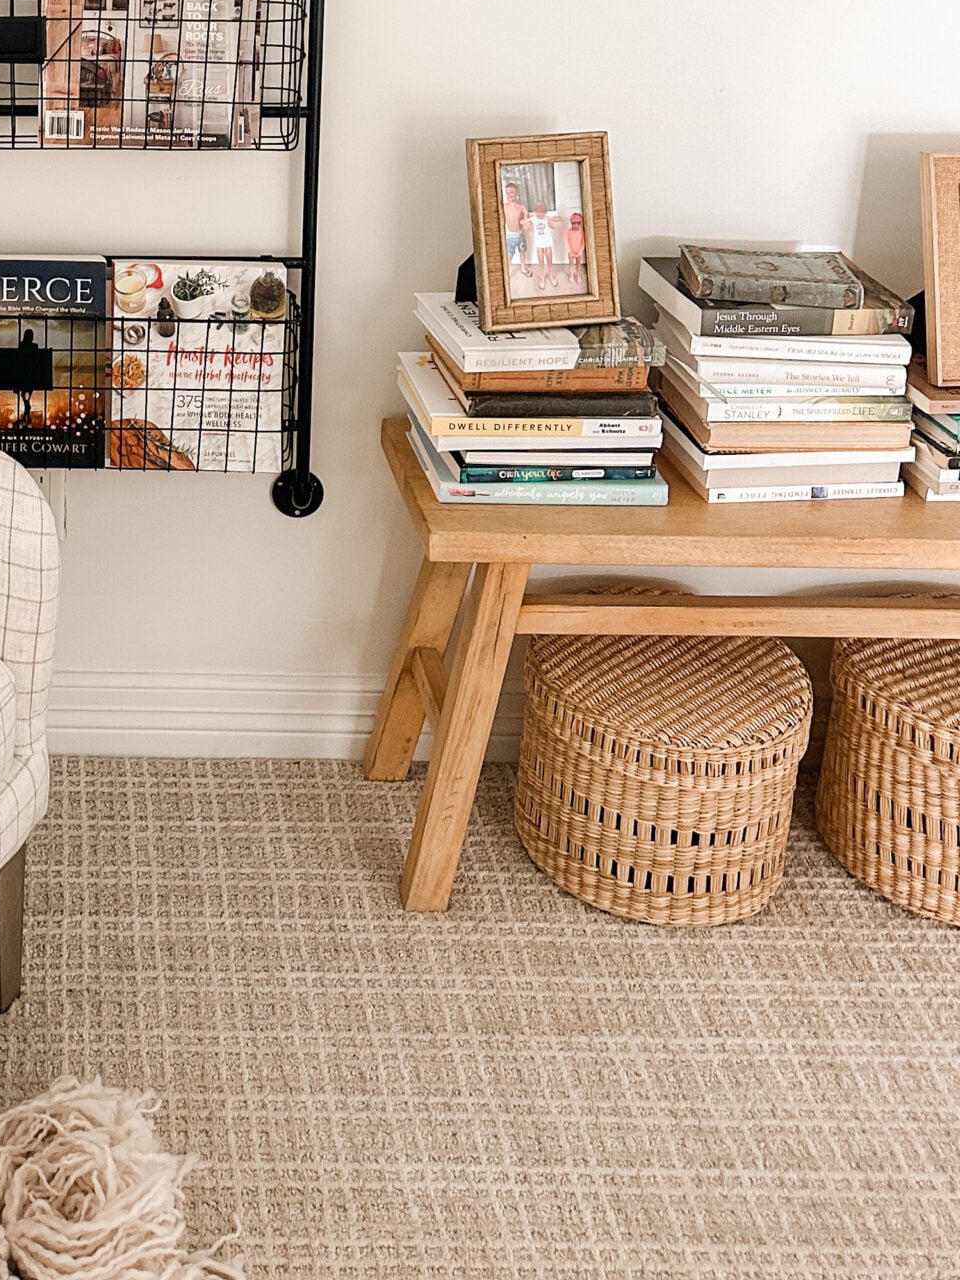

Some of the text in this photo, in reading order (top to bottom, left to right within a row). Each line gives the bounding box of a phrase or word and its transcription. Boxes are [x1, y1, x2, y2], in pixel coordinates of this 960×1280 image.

[186, 2, 218, 12] BACK
[186, 12, 202, 20] TO
[185, 22, 218, 31] YOUR
[185, 31, 224, 41] ROOTS
[178, 80, 222, 96] Pus
[714, 312, 778, 323] Jesus Through
[713, 324, 801, 335] Middle Eastern Eyes
[223, 344, 274, 370] Recipes
[475, 356, 569, 368] RESILIENT HOPE
[785, 372, 860, 383] The Stories We Tell
[176, 394, 203, 409] 375
[724, 409, 771, 419] STANLEY
[852, 406, 876, 416] LIFE
[448, 422, 573, 432] DWELL DIFFERENTLY
[31, 441, 88, 454] COWART
[521, 469, 546, 481] your
[589, 491, 609, 502] you
[770, 491, 809, 499] FINDING
